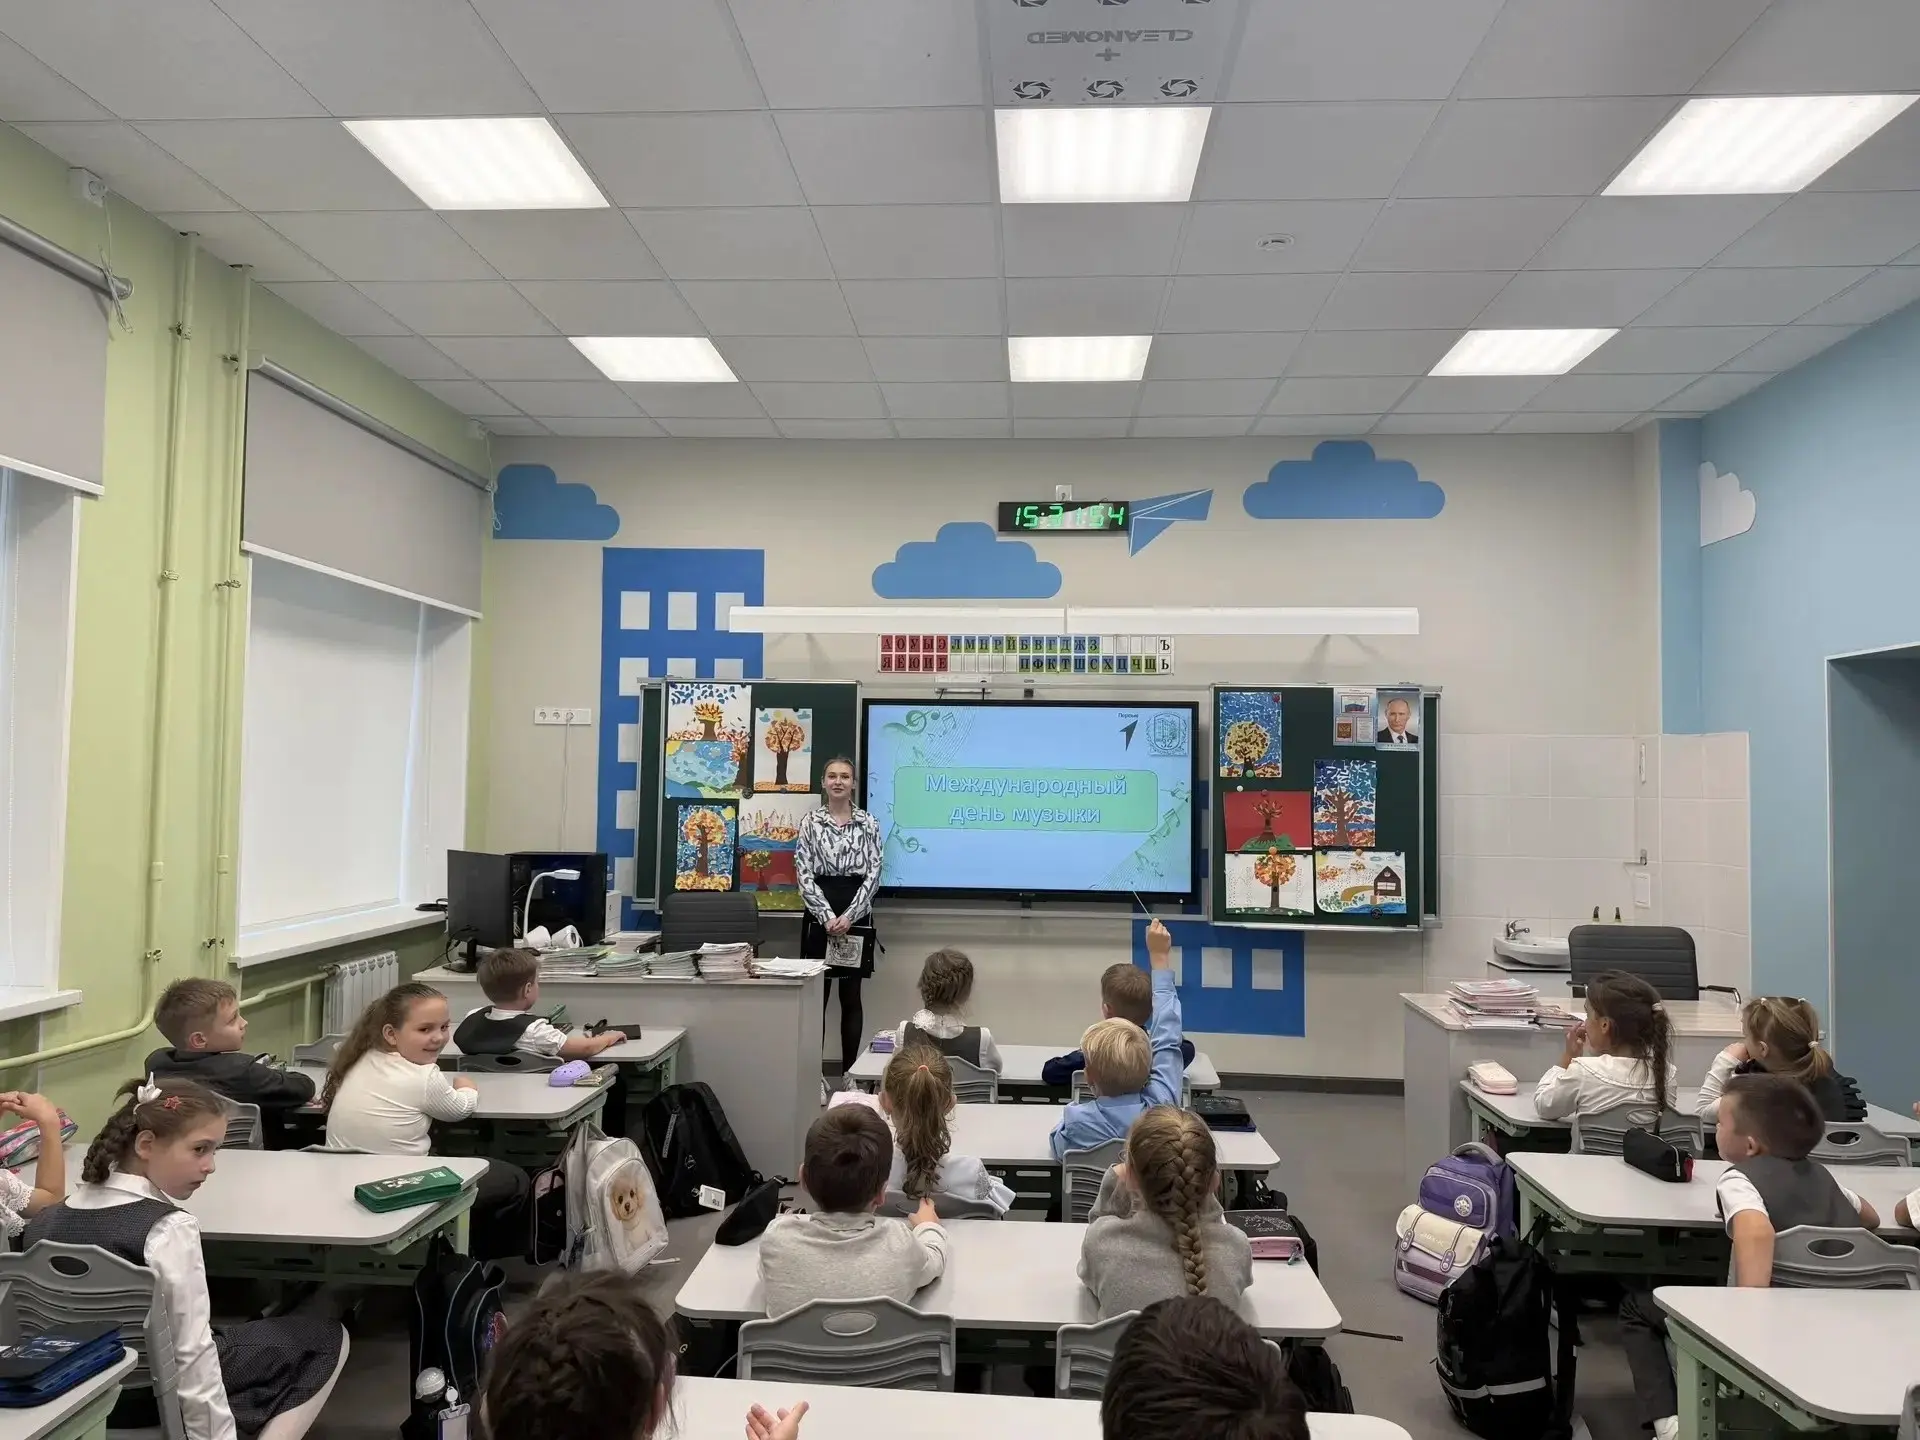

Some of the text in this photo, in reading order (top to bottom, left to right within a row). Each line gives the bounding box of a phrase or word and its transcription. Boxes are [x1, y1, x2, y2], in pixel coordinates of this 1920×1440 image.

[1027, 29, 1193, 44] CLEANOMED
[924, 774, 1127, 797] Международный
[949, 806, 1101, 826] день музыки
